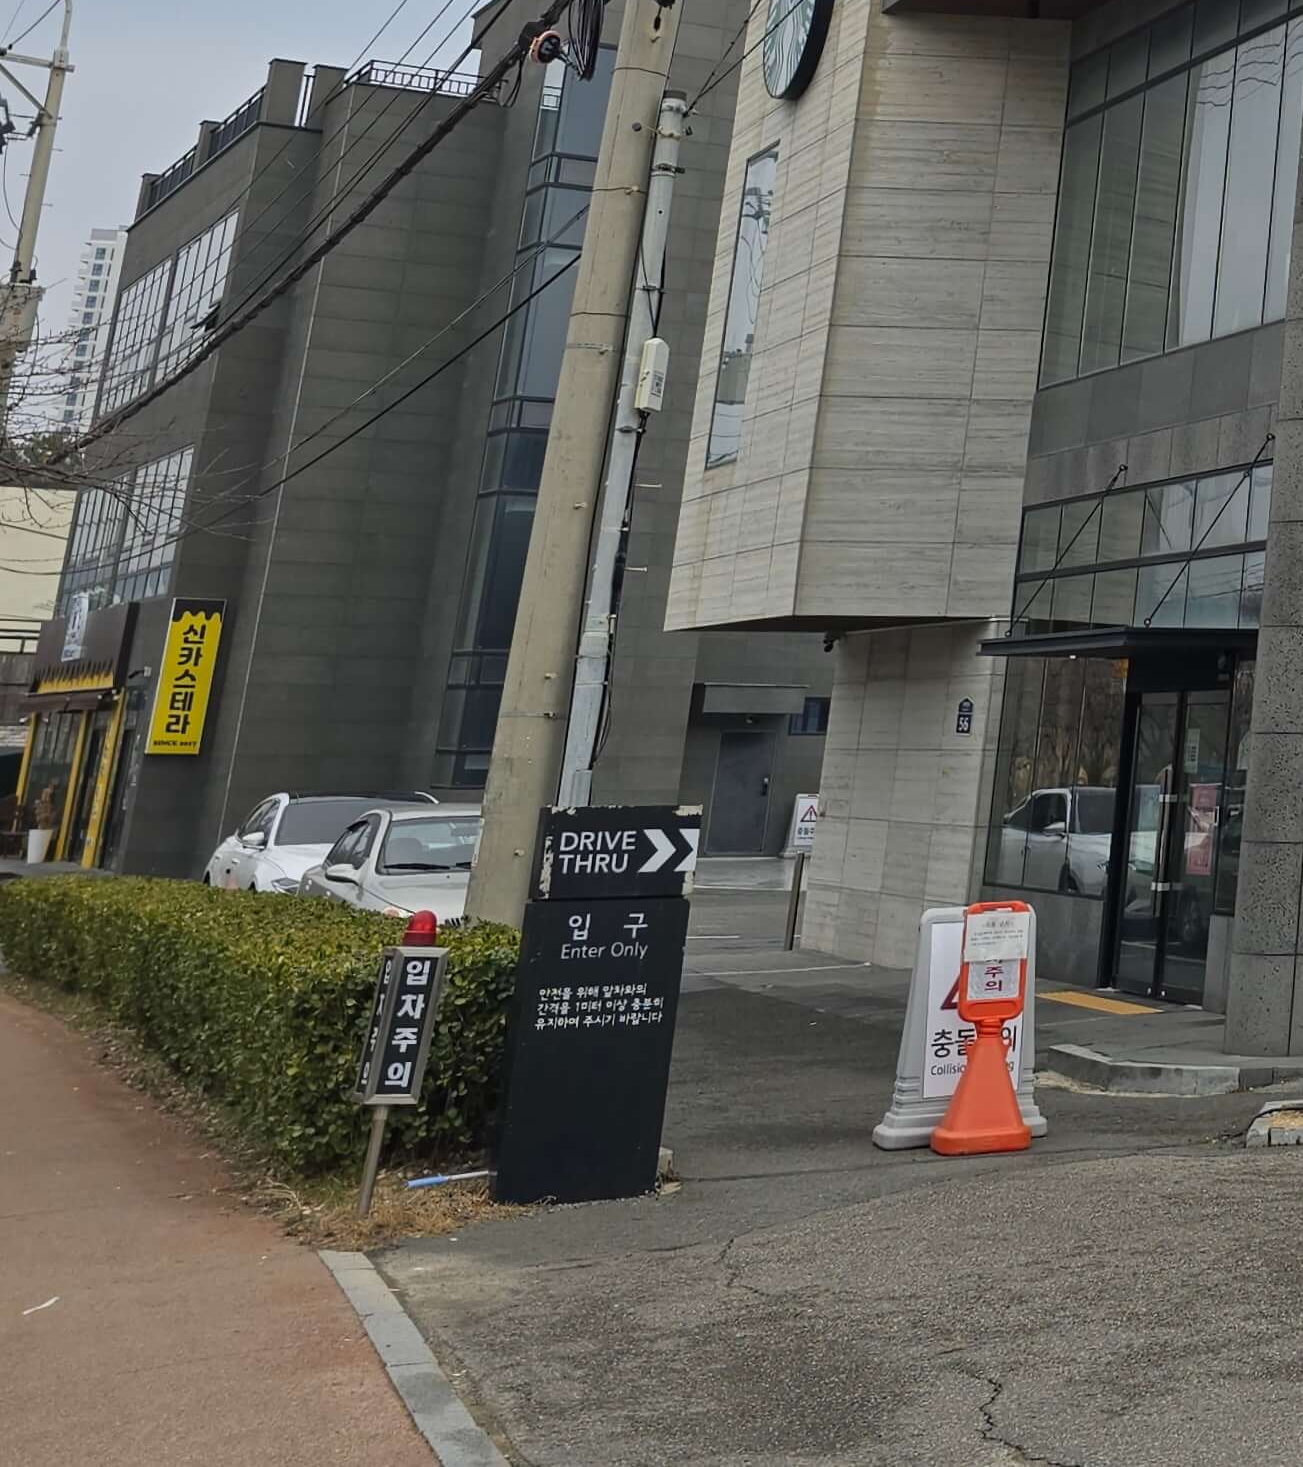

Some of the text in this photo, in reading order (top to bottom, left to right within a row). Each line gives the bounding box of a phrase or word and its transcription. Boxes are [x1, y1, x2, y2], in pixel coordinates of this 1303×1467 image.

[164, 624, 207, 735] 신카스테라
[559, 830, 637, 851] DRIVE
[558, 853, 629, 874] THRU
[568, 913, 649, 941] 입 구
[560, 941, 649, 960] Enter Only
[538, 986, 573, 1001] 안전을
[576, 985, 600, 999] 위해
[536, 1001, 571, 1016] 간격을
[575, 999, 602, 1013] 1미터
[605, 998, 628, 1012] 이상
[534, 1011, 663, 1031] 유지하여 주시기 바랍니다
